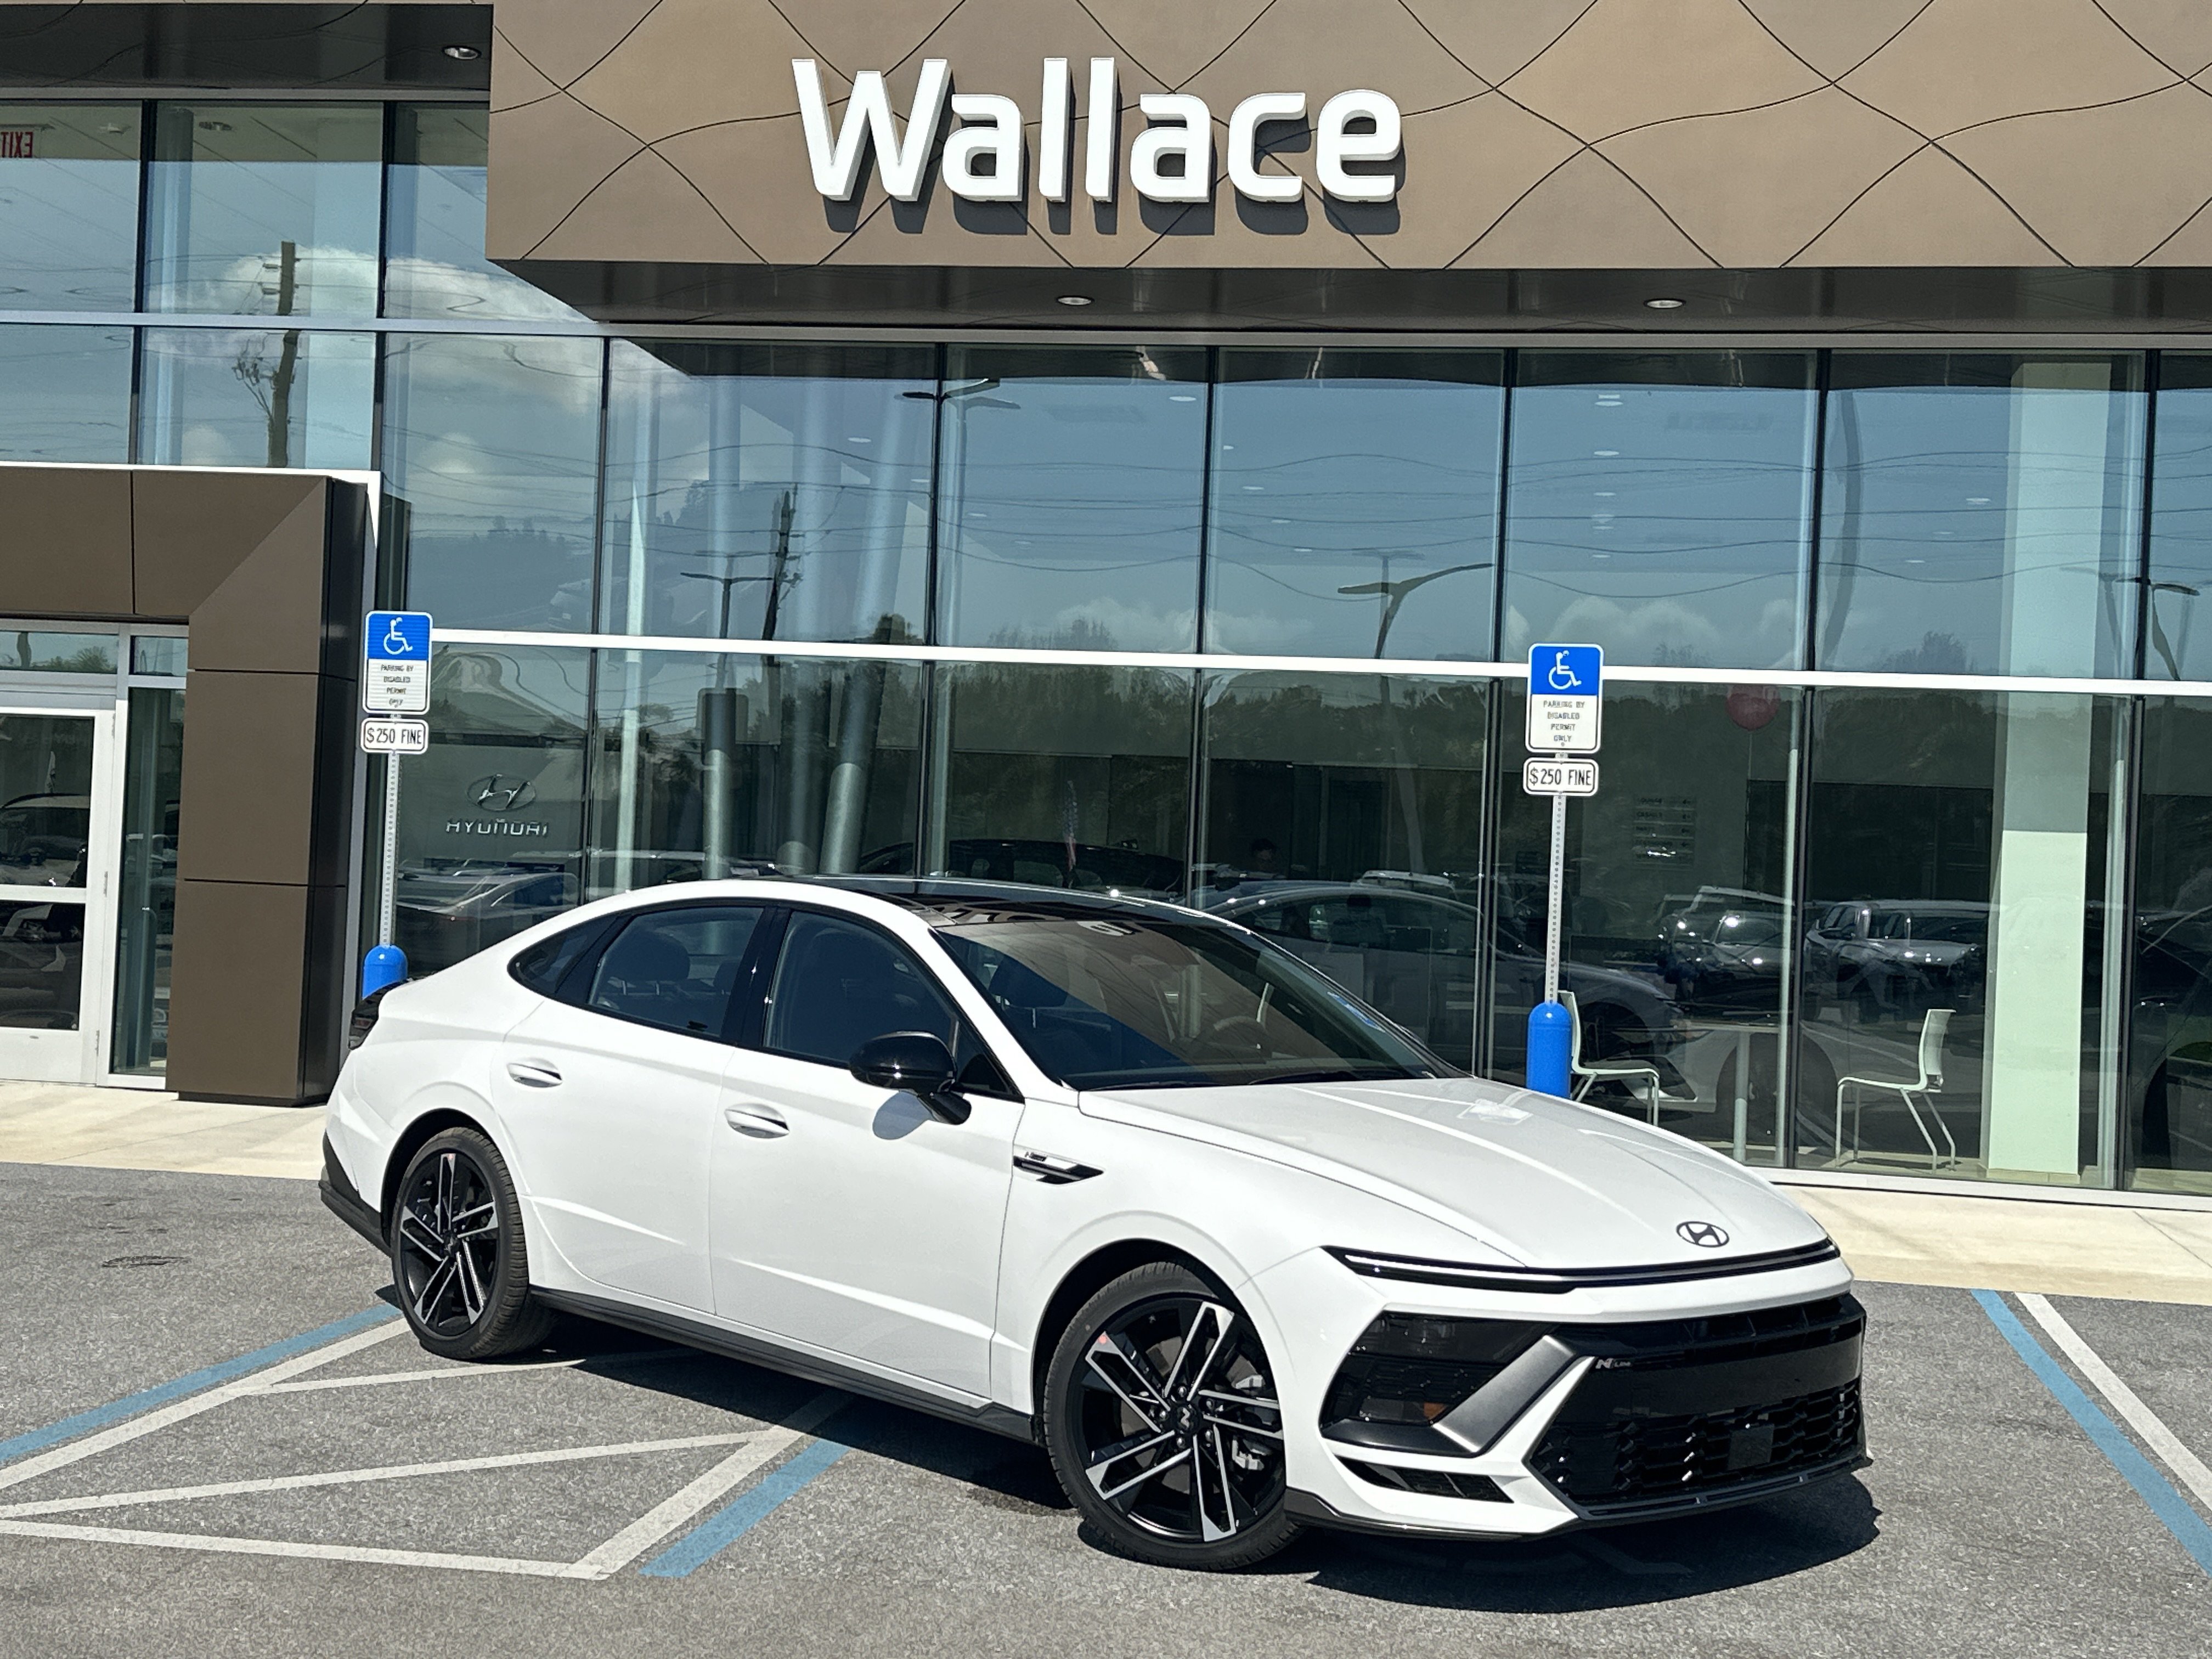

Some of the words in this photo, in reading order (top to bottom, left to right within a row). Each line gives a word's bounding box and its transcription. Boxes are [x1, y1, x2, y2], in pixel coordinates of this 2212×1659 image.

[791, 57, 1402, 202] Wallace
[366, 727, 396, 743] $250
[400, 729, 422, 744] FINE
[1529, 767, 1562, 786] $250
[1567, 769, 1592, 786] FINE
[445, 819, 549, 836] HYUNDAI
